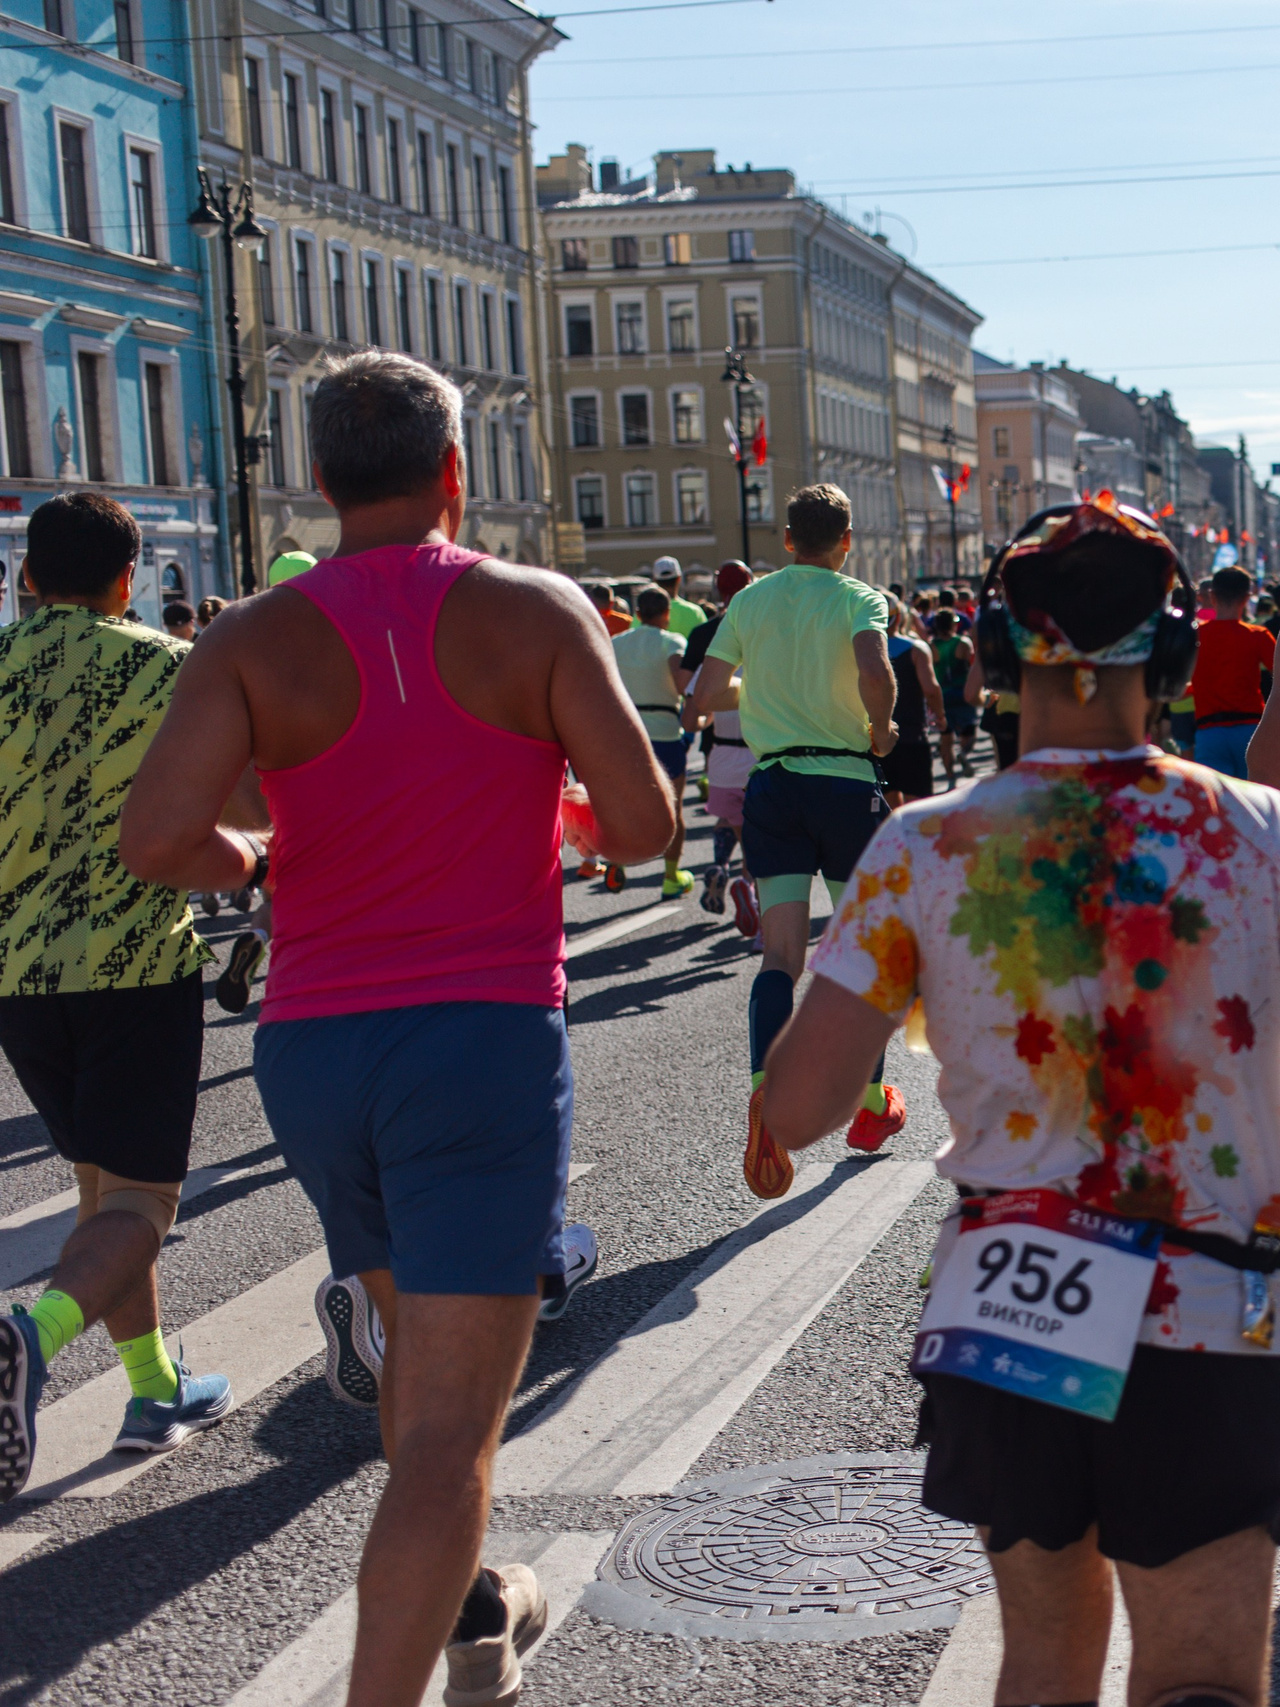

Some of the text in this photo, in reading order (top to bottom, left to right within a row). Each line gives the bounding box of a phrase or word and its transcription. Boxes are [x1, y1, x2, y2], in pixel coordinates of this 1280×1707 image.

[1105, 1218, 1135, 1241] КМ
[974, 1238, 1093, 1316] 956
[978, 1300, 1064, 1336] ВИКТОР
[918, 1334, 944, 1365] D
